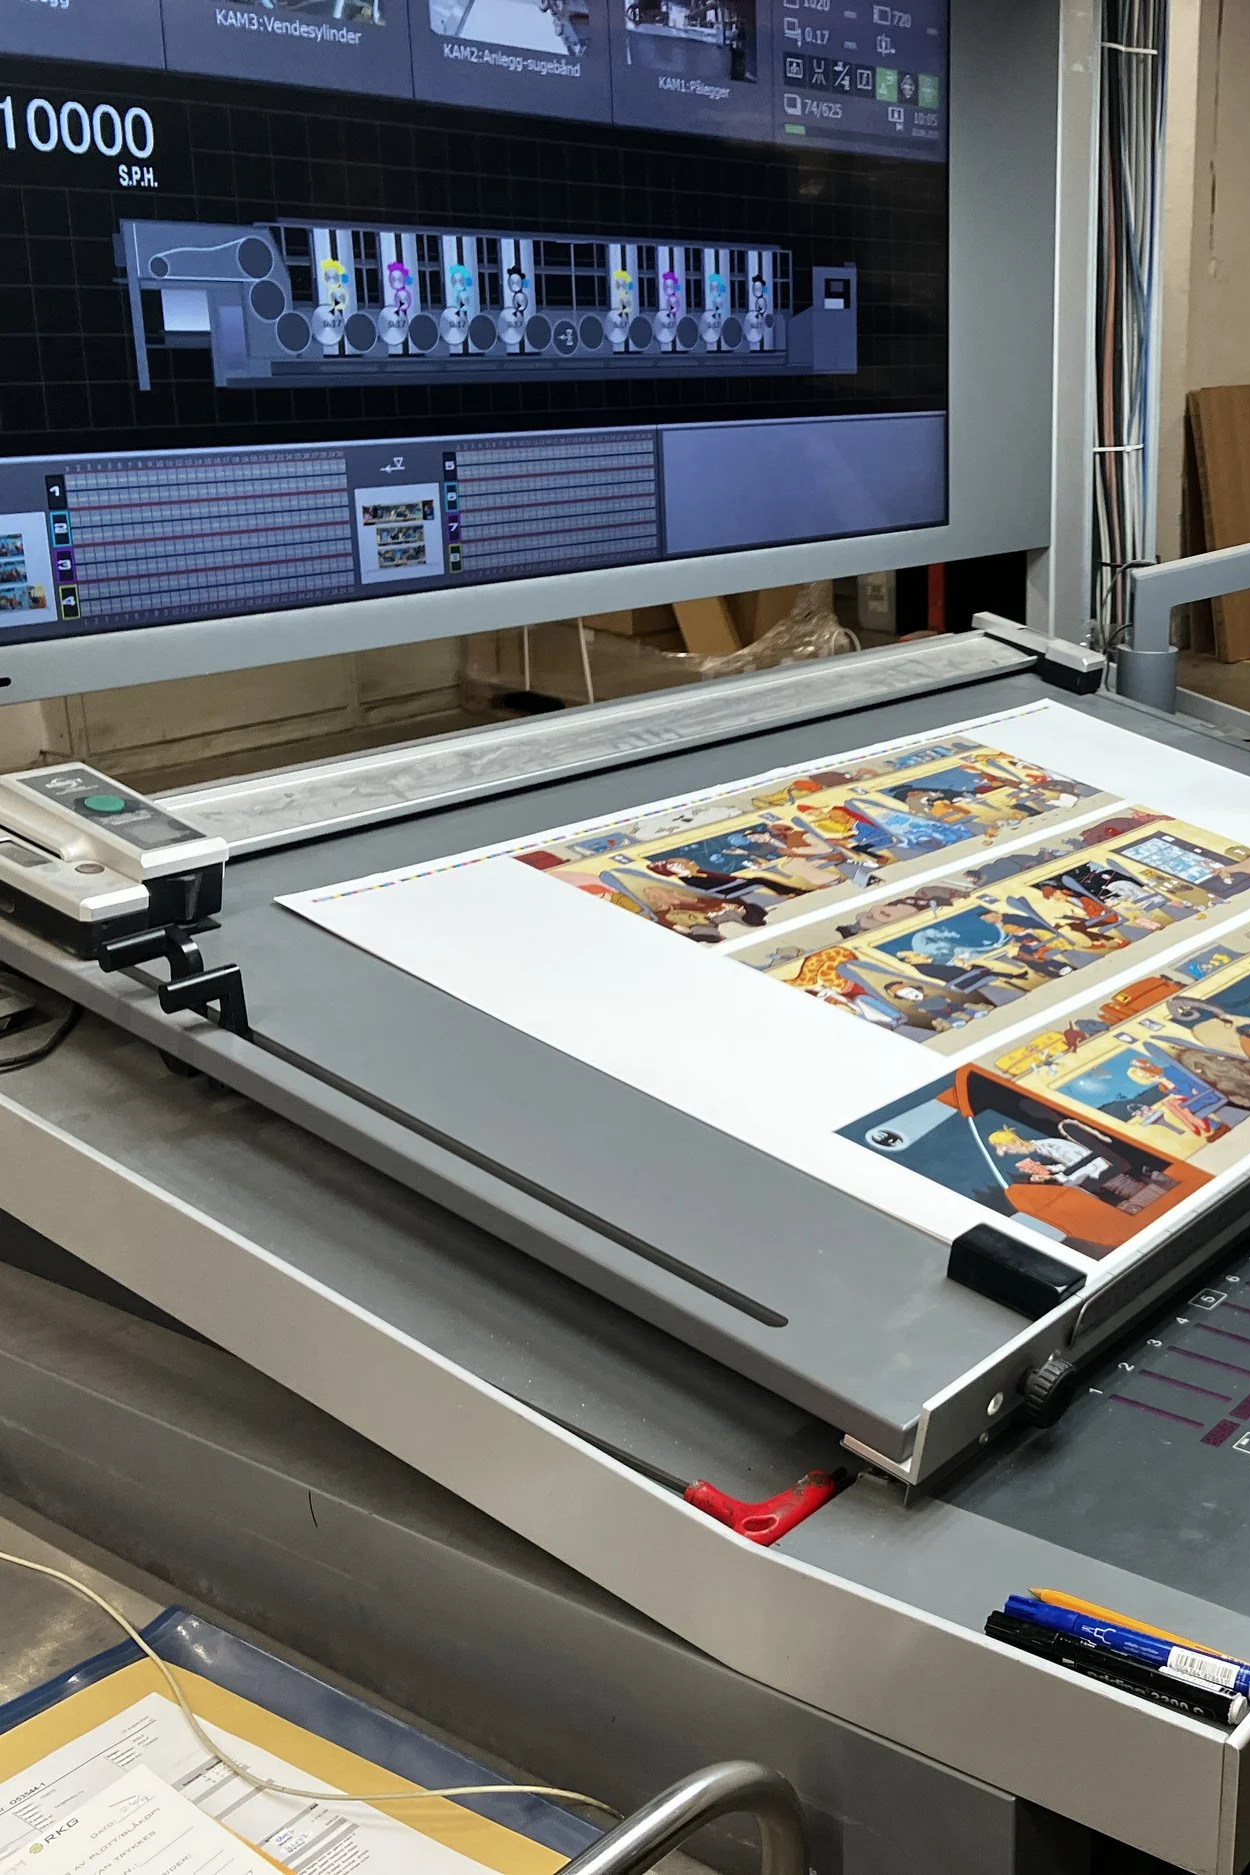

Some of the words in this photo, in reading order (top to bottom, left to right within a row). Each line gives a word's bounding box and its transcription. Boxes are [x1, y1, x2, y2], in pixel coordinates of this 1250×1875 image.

[215, 8, 362, 45] KAM3:Vendesylinder
[804, 27, 830, 45] 0.17
[804, 99, 843, 119] 74/625
[1, 95, 155, 159] 10000
[118, 164, 158, 188] S.P.H.
[49, 485, 60, 497] 1
[54, 522, 68, 535] 2
[448, 522, 458, 532] 7
[58, 559, 72, 571] 3
[61, 595, 76, 607] 4
[1225, 1274, 1240, 1282] 6
[1200, 1295, 1216, 1303] 5
[1176, 1316, 1190, 1324] 4
[1147, 1339, 1163, 1347] 3
[1118, 1362, 1135, 1371] 2
[44, 1817, 79, 1843] RKG
[114, 1830, 156, 1861] TRYKKES
[75, 1861, 86, 1871] AV
